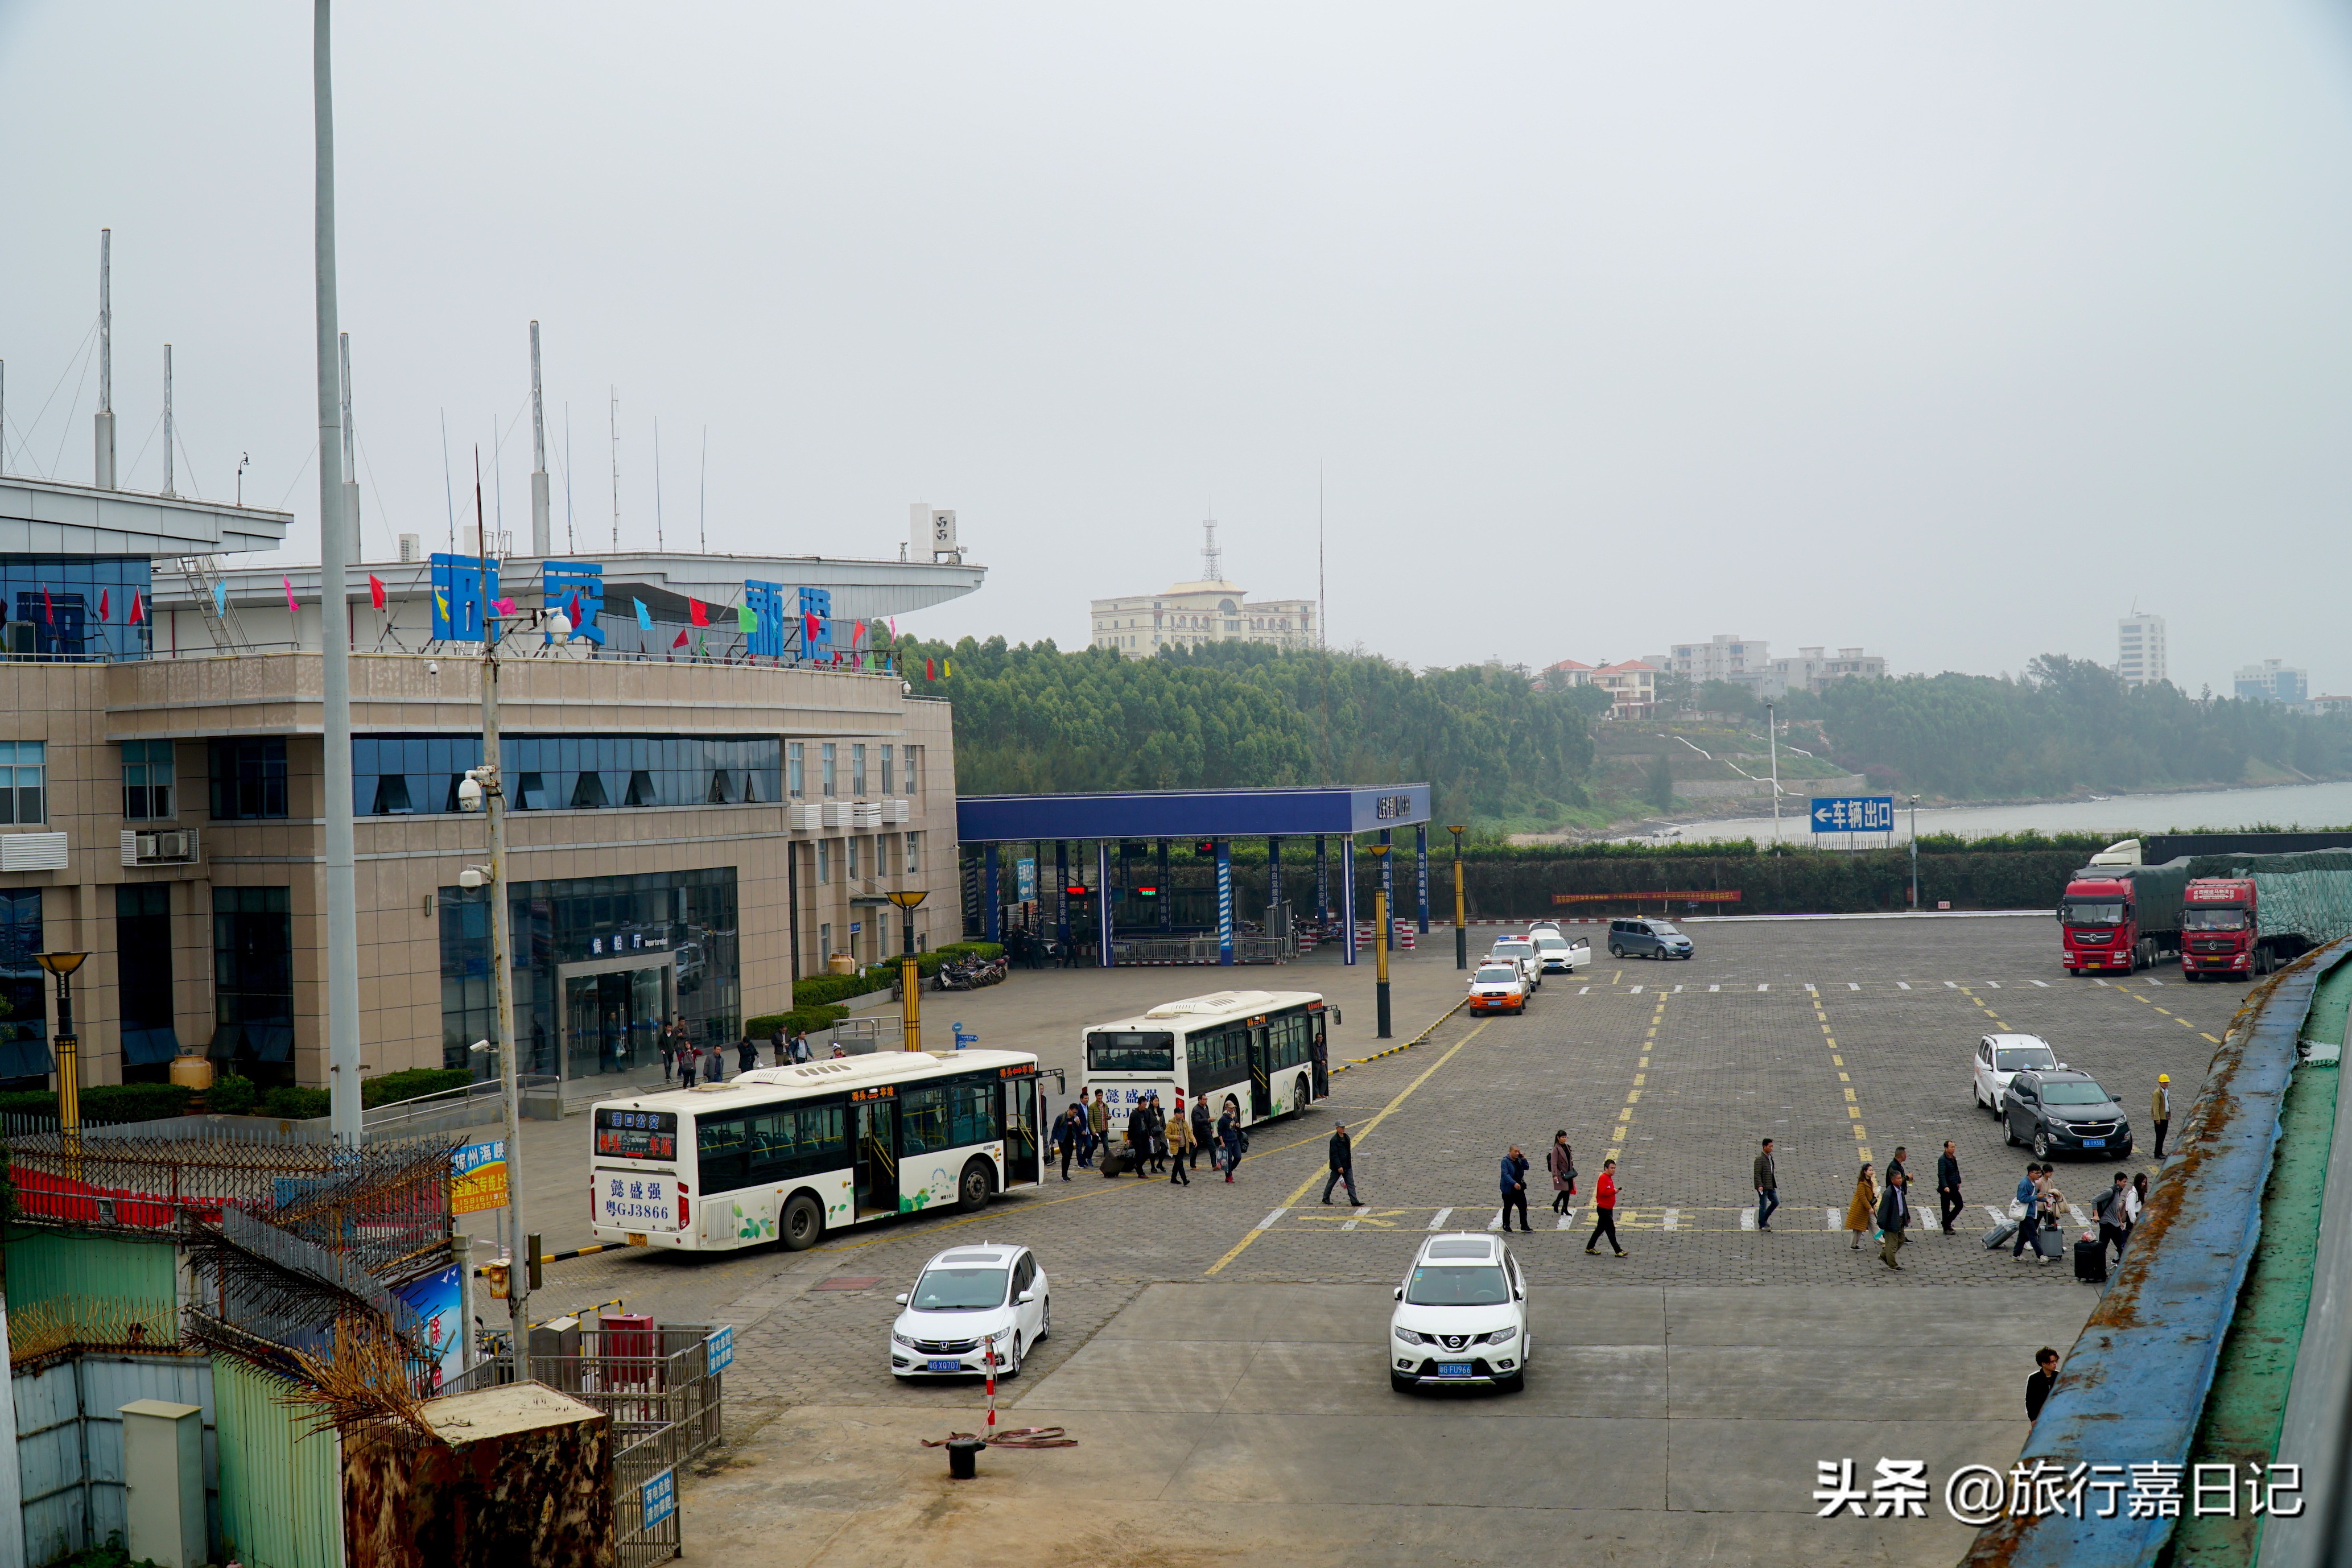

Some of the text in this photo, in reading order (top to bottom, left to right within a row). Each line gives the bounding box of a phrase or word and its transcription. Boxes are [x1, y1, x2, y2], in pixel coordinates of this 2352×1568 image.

[1833, 799, 1891, 829] 车辆出口
[1018, 864, 1034, 883] 车辆出口
[1058, 868, 1067, 925] 请自觉接受安检
[593, 934, 641, 954] 候船厅
[1000, 1063, 1034, 1078] 码头 车站
[852, 1086, 894, 1102] 码头 车站
[611, 1112, 659, 1129] 港口公交
[599, 1133, 672, 1156] 码头 车站
[610, 1179, 662, 1200] 懿盛强
[460, 1198, 507, 1213] 135435715
[605, 1199, 669, 1220] 粤GJ3866
[630, 1237, 647, 1247] J3866
[709, 1332, 731, 1356] 有电危险
[710, 1347, 732, 1371] 请勿攀爬
[646, 1476, 671, 1505] 有电危险
[646, 1495, 671, 1524] 请勿攀爬
